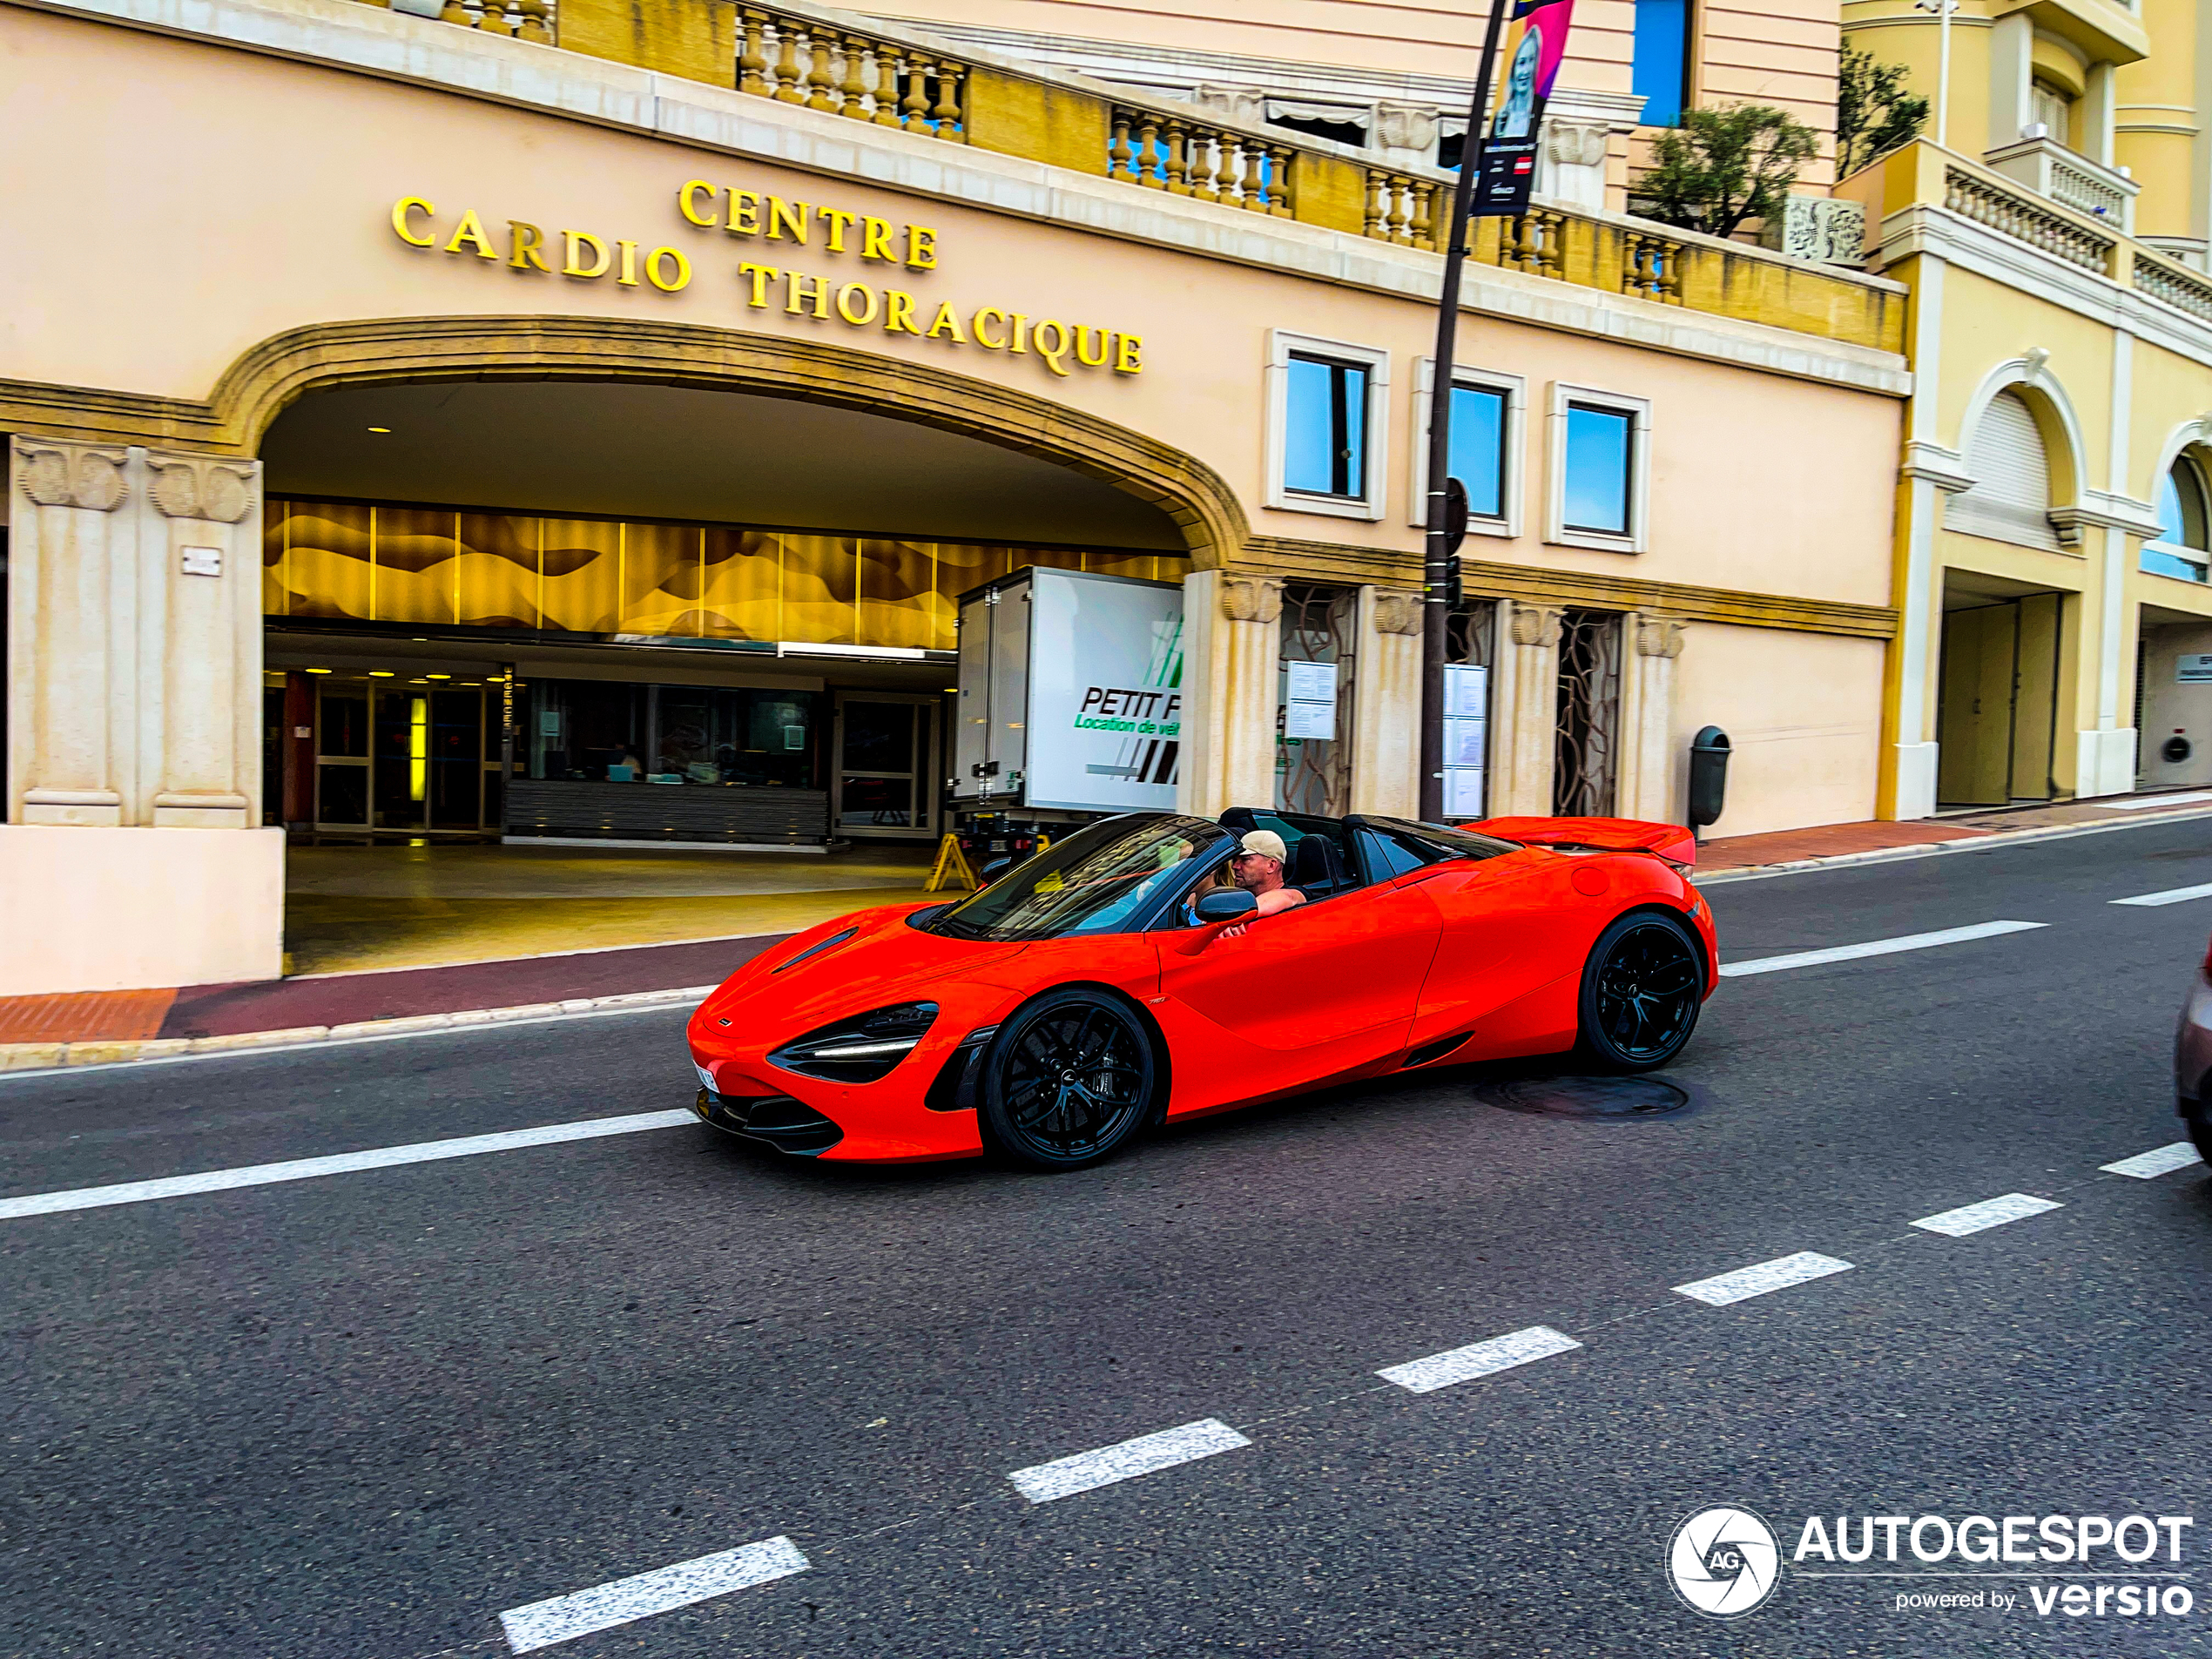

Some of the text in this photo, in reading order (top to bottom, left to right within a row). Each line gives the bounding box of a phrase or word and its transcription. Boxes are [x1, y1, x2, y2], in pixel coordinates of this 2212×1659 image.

[678, 179, 938, 271] CENTRE
[392, 196, 1144, 377] CARDIO THORACIQUE
[1074, 714, 1136, 732] Location
[1137, 719, 1157, 734] de
[1079, 686, 1163, 718] PETIT
